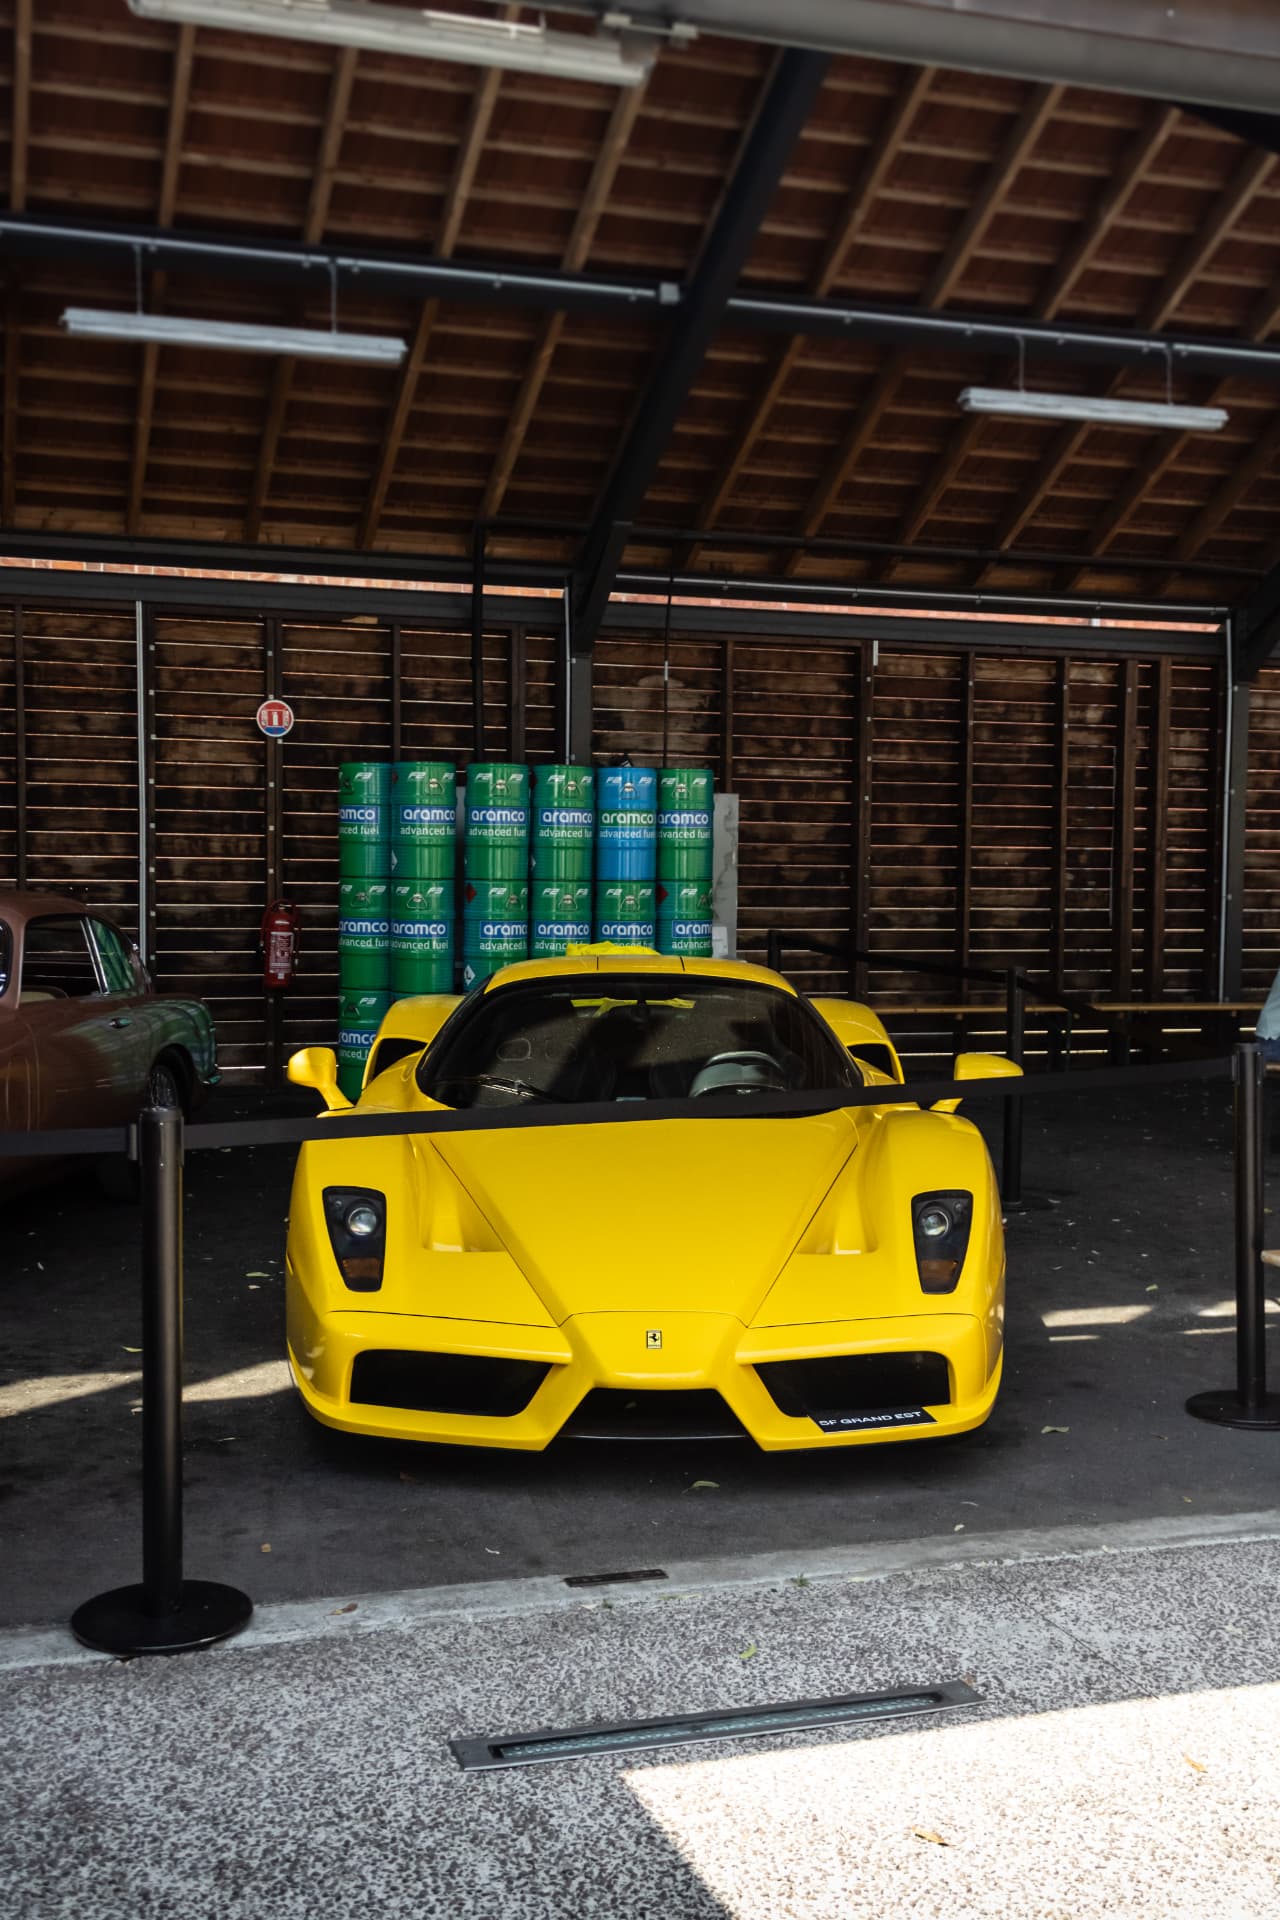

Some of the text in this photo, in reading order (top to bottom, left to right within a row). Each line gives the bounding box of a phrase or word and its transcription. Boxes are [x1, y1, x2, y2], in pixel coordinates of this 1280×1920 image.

[403, 808, 456, 821] aramco
[471, 809, 525, 822] aramco
[542, 811, 592, 823] aramco
[601, 812, 655, 824] aramco
[657, 813, 709, 825] aramco
[360, 825, 379, 835] fuel
[400, 826, 446, 836] advanced
[468, 827, 512, 837] advanced
[539, 828, 582, 838] advanced
[600, 829, 642, 839] advanced
[537, 924, 590, 936] aramco
[601, 924, 654, 936] aramco
[675, 924, 712, 936] aram
[535, 941, 566, 950] advanc
[840, 1414, 893, 1424] GRAND
[894, 1411, 921, 1419] EST
